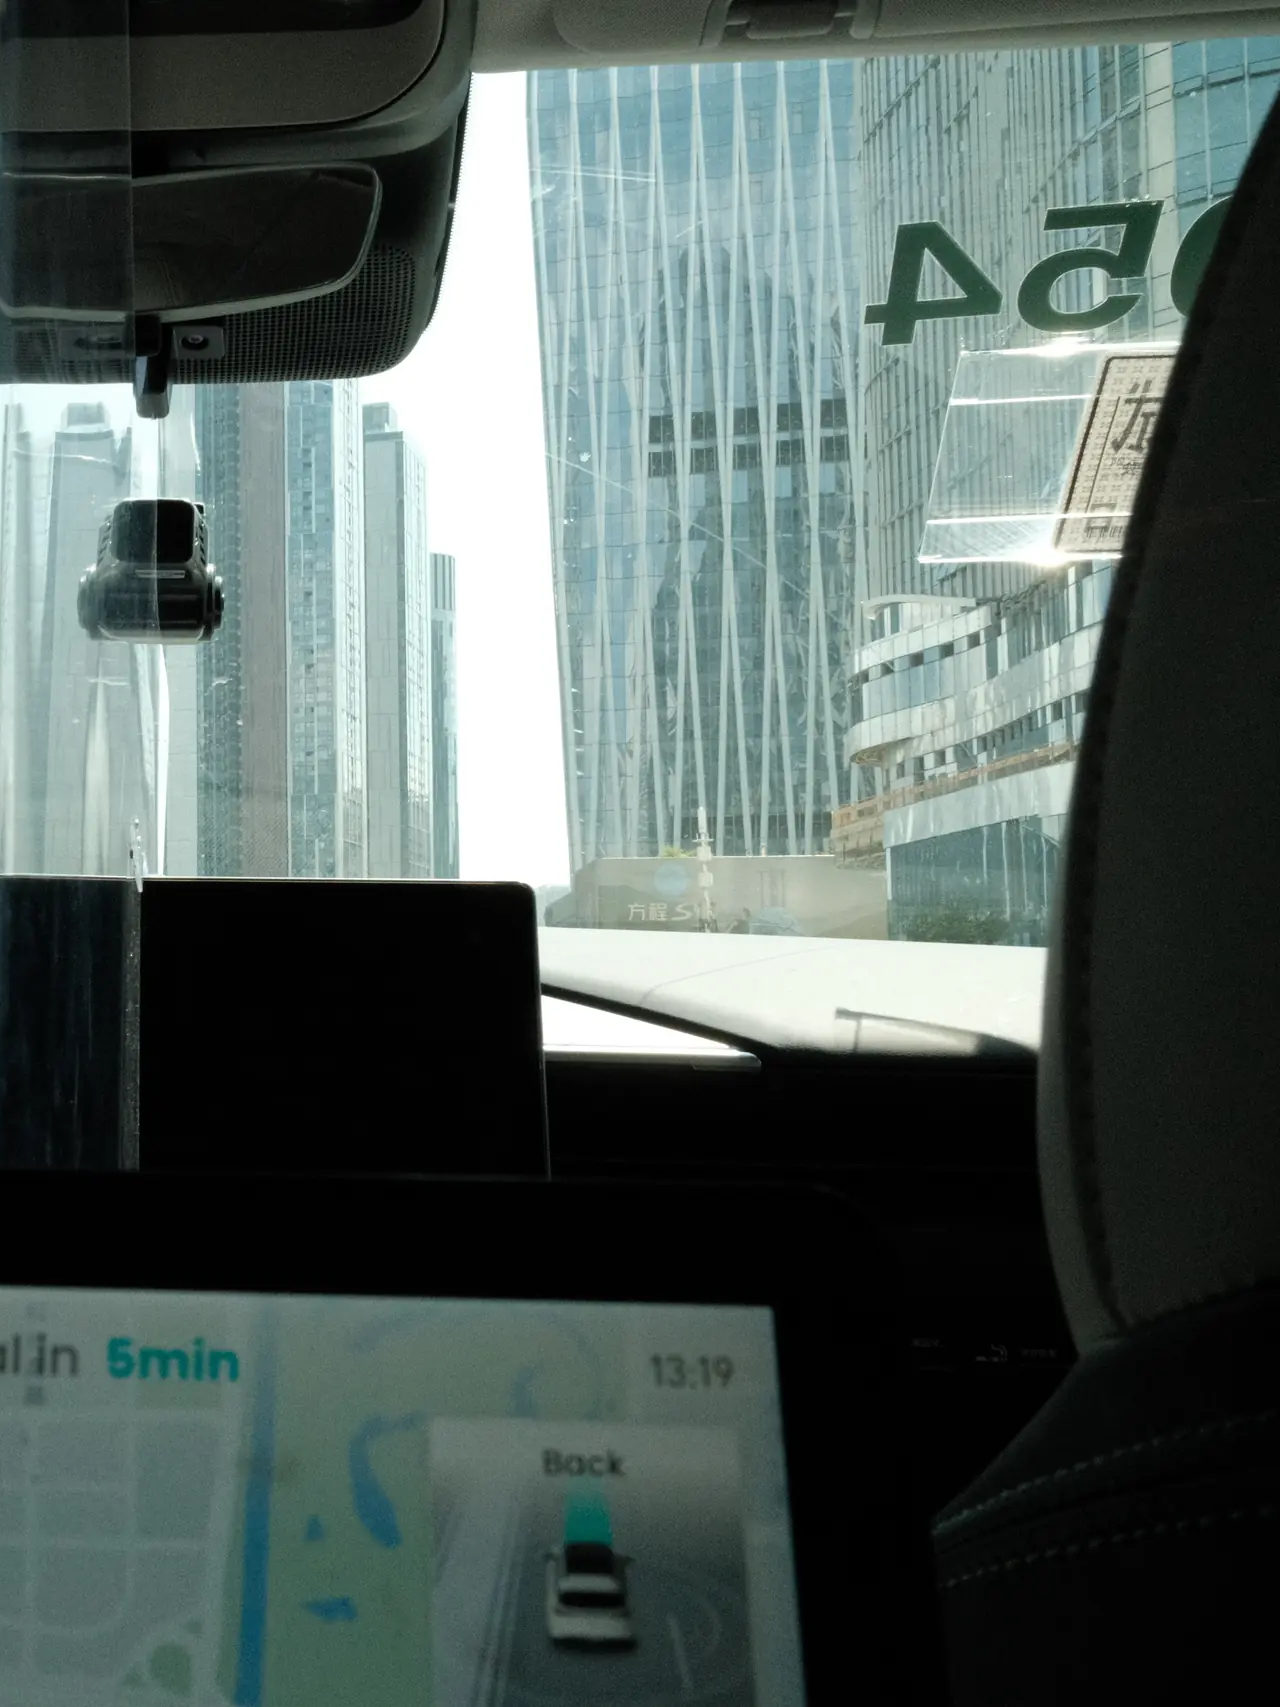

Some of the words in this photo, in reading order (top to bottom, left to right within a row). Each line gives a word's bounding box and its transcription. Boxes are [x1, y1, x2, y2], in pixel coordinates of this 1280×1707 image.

[37, 1333, 80, 1377] in
[106, 1336, 240, 1382] 5min
[650, 1354, 734, 1388] 13:19
[542, 1448, 624, 1475] Back
